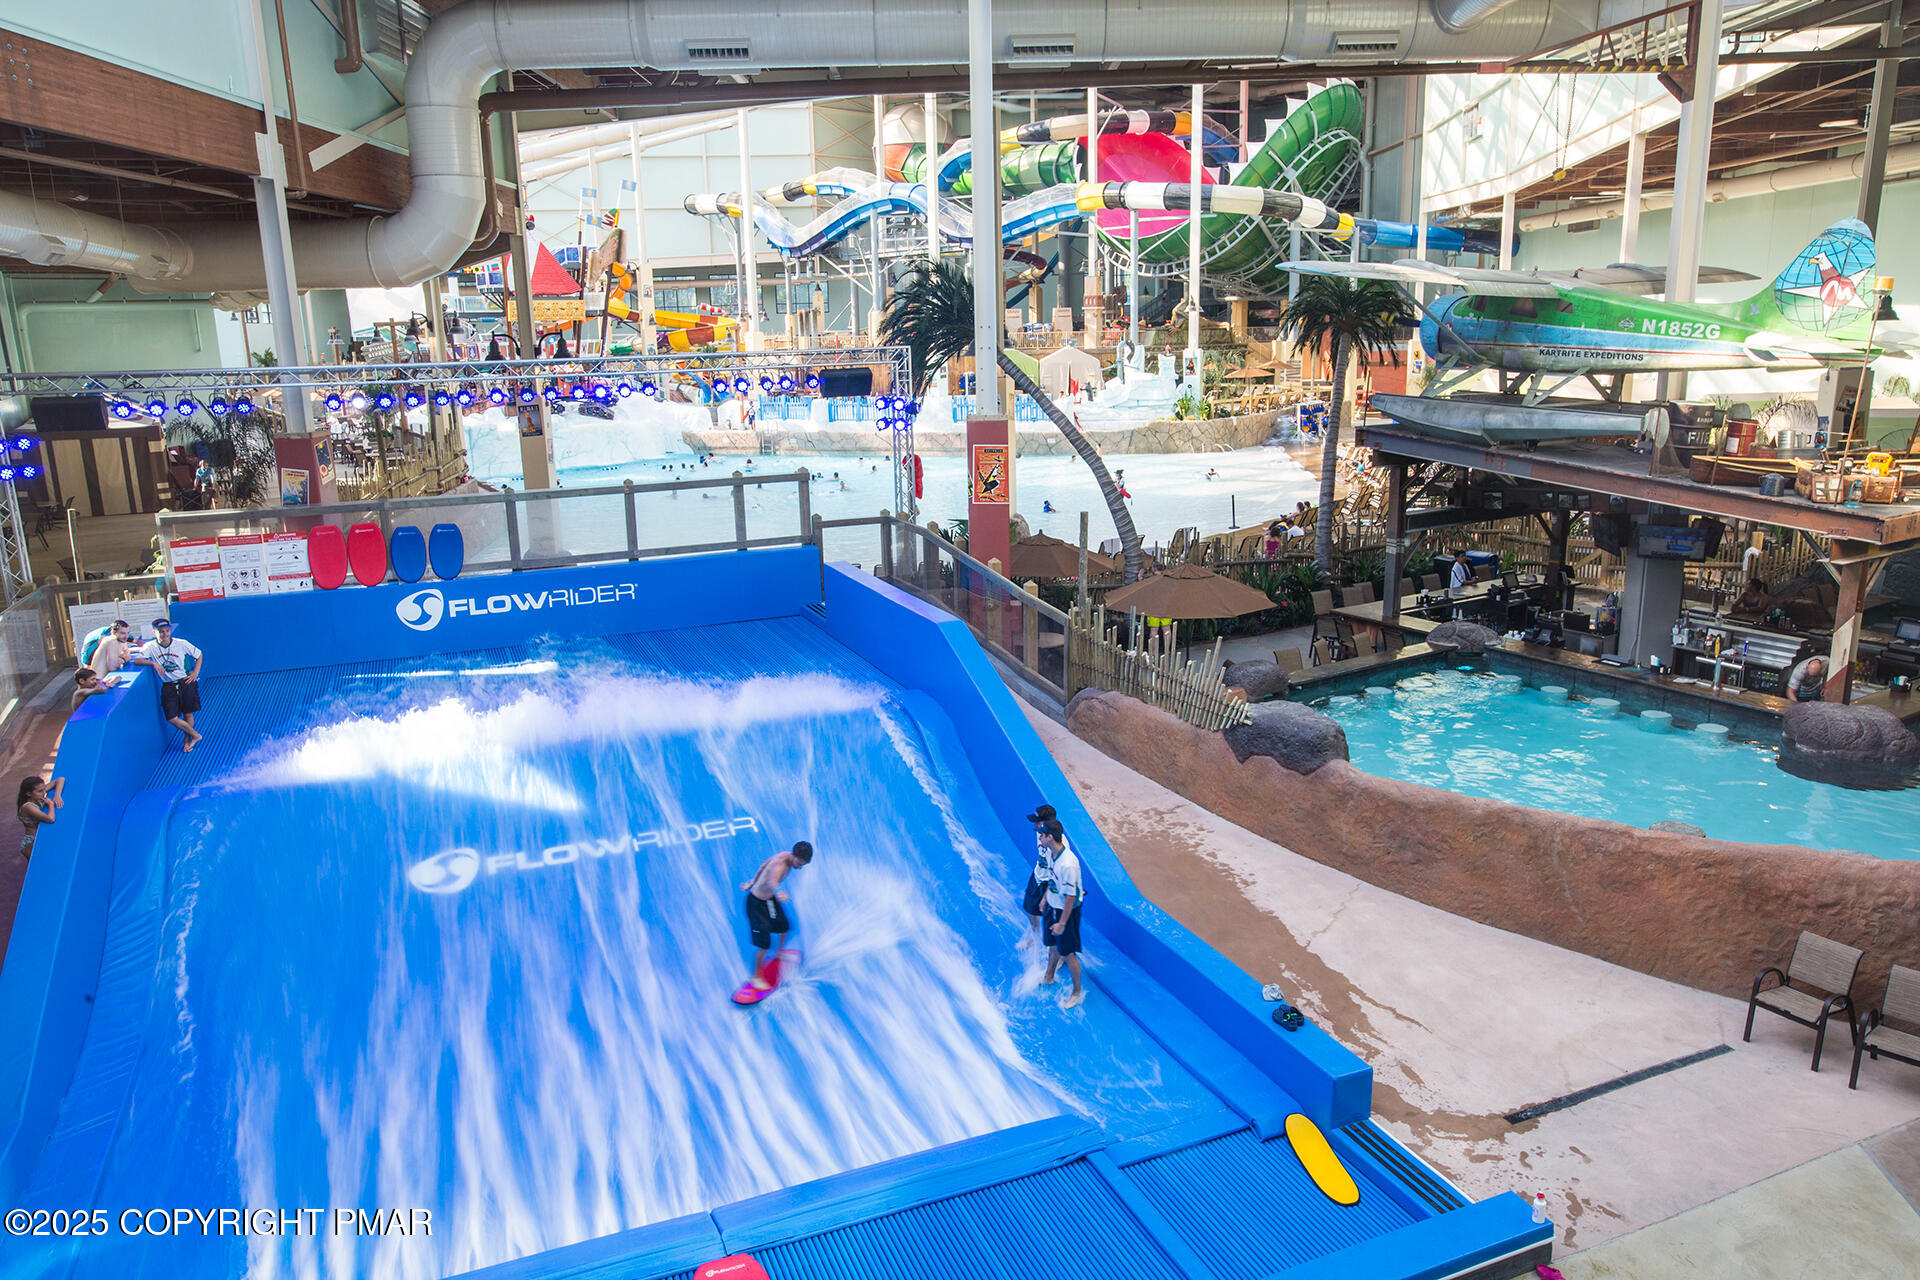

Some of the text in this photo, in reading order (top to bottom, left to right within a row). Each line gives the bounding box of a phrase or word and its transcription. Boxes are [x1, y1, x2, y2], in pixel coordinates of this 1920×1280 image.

[1642, 318, 1721, 339] N1852G
[1539, 348, 1644, 361] KARTRITE EXPEDITIONS
[448, 583, 638, 618] FLOWRIDER
[487, 816, 759, 875] FLOWRIDER
